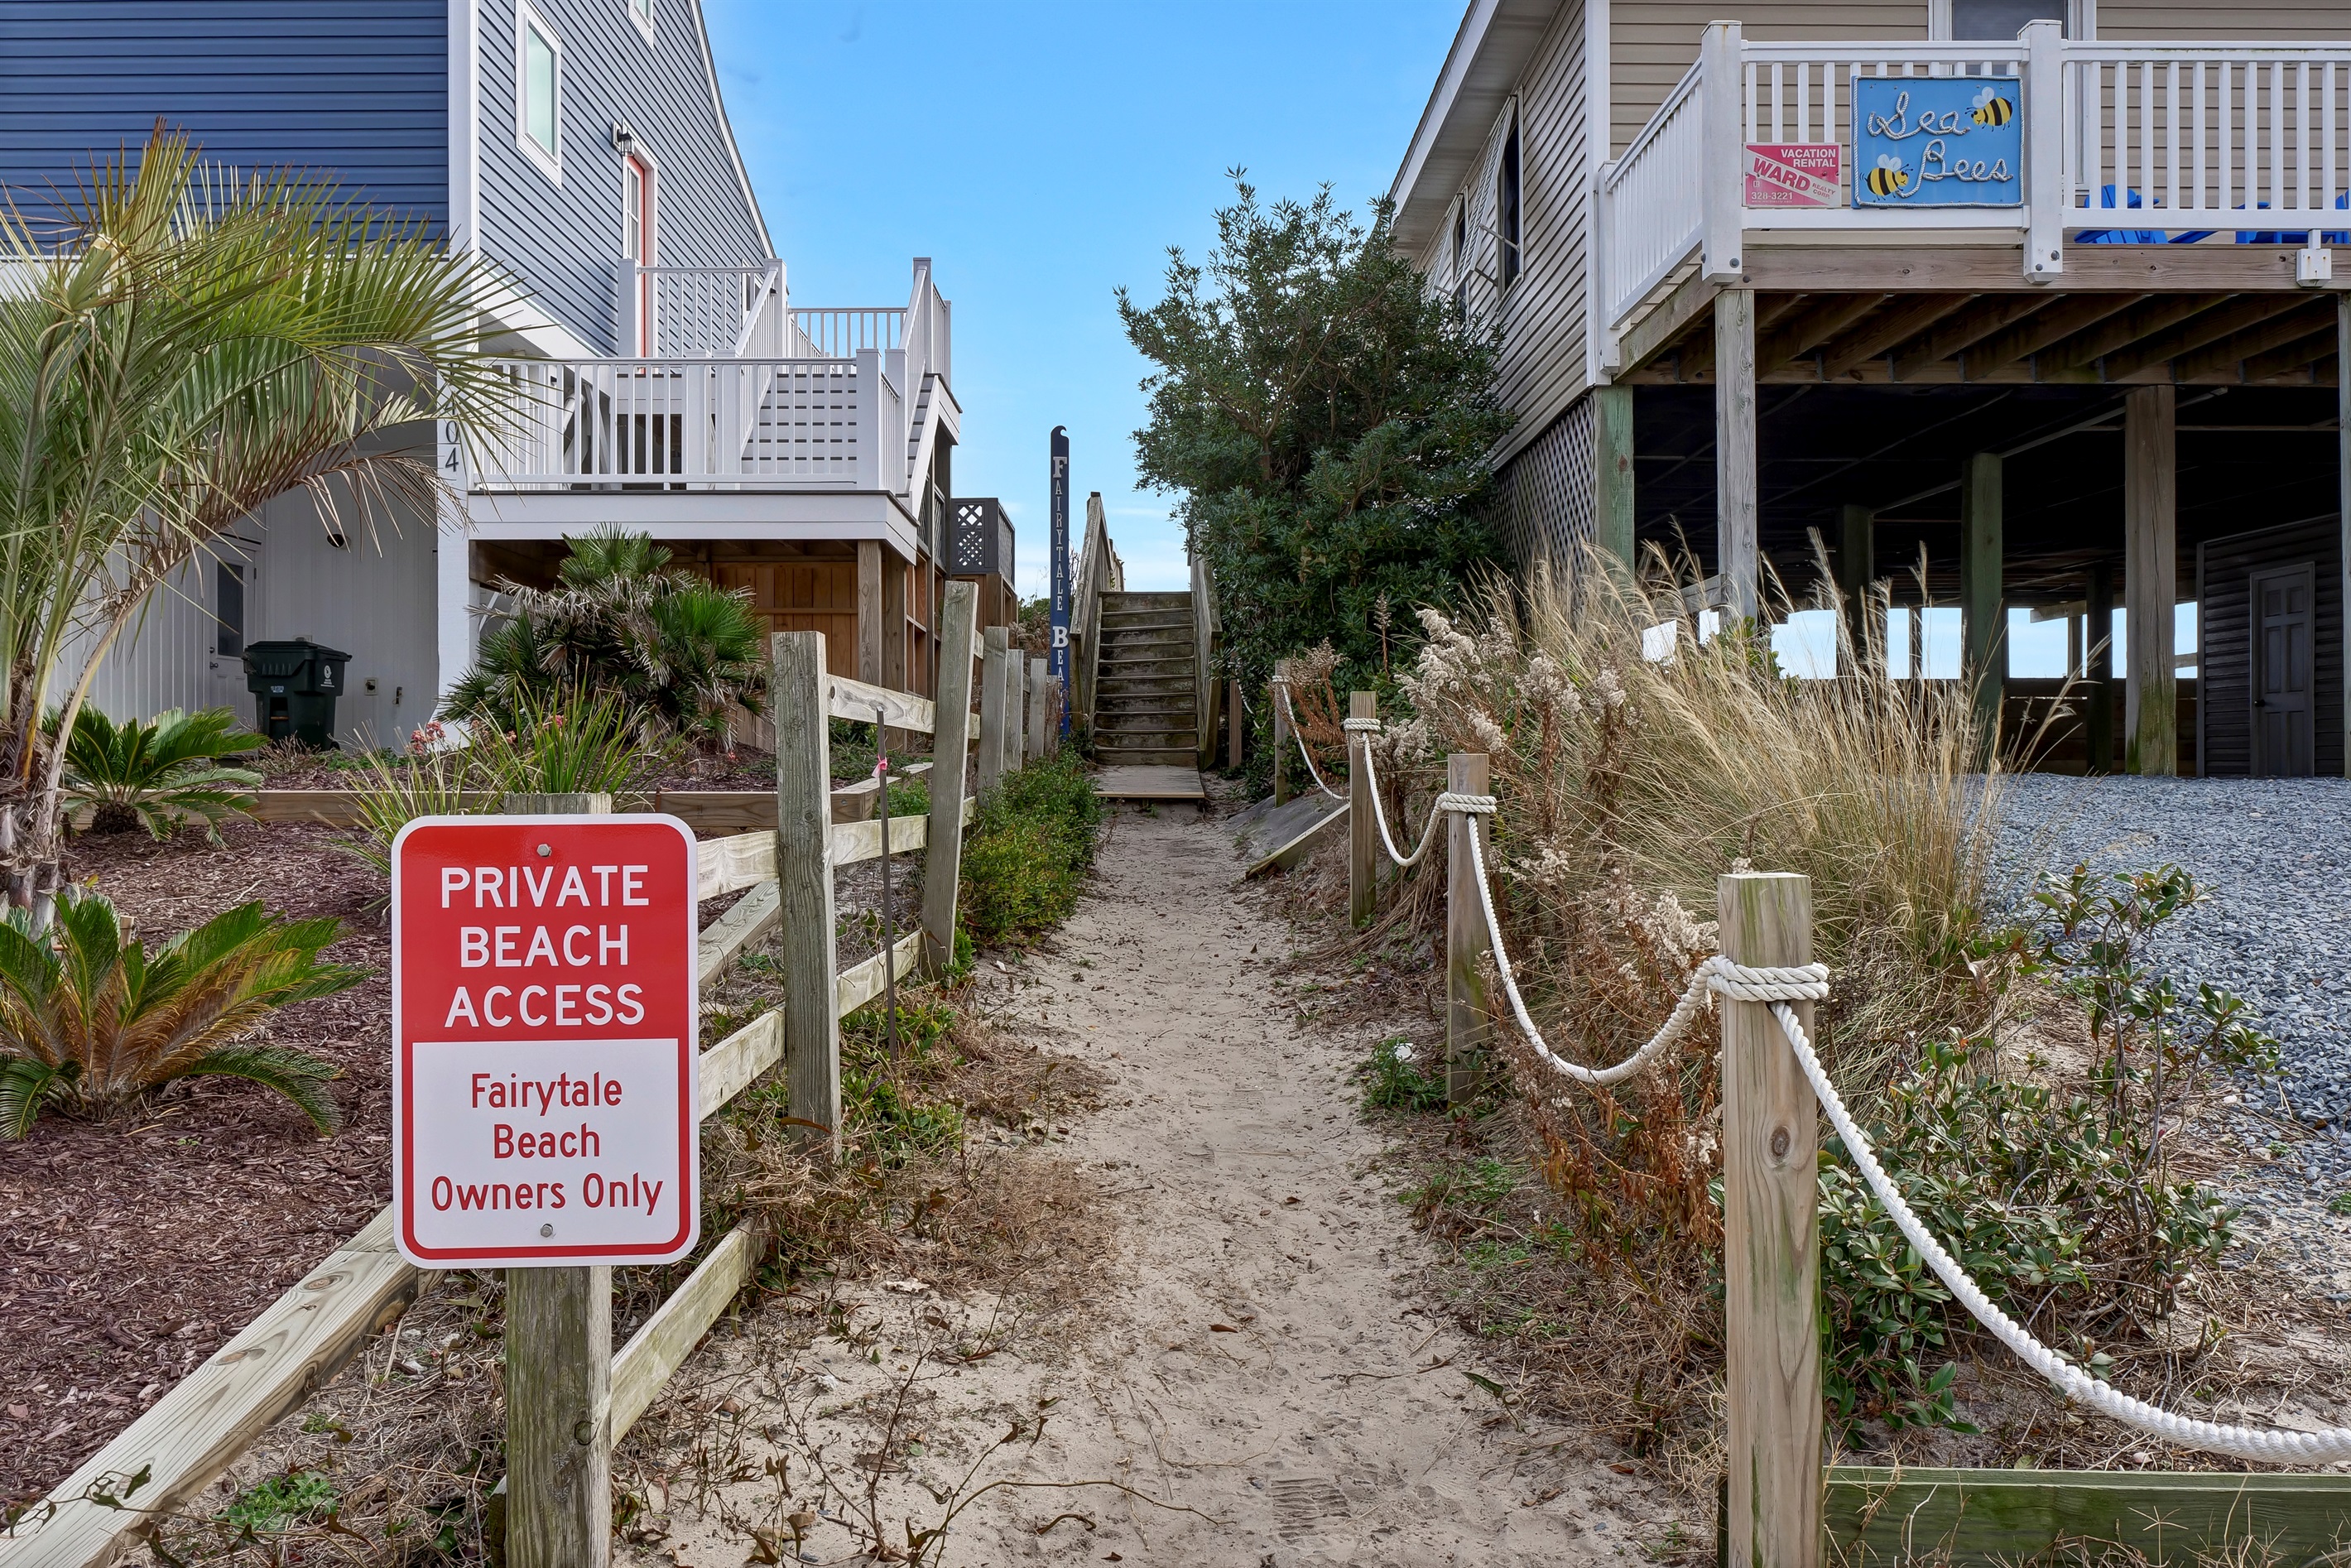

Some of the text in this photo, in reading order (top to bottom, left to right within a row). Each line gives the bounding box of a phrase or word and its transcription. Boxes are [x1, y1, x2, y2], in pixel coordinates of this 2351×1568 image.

[1867, 91, 1970, 140] Sea
[1752, 156, 1811, 192] WARD
[1781, 148, 1836, 158] VACATION
[1793, 158, 1836, 167] RENTAL
[1897, 139, 2014, 198] Bees
[1751, 191, 1793, 200] 328-3221
[1812, 182, 1836, 195] REALTY
[1052, 456, 1069, 714] FAIRYTALE BEA
[441, 864, 650, 908] PRIVATE
[460, 924, 628, 968] BEACH
[444, 984, 645, 1028] ACCESS
[471, 1072, 623, 1116] Fairytale
[493, 1123, 600, 1159] Beach
[431, 1172, 663, 1216] Owners Only
